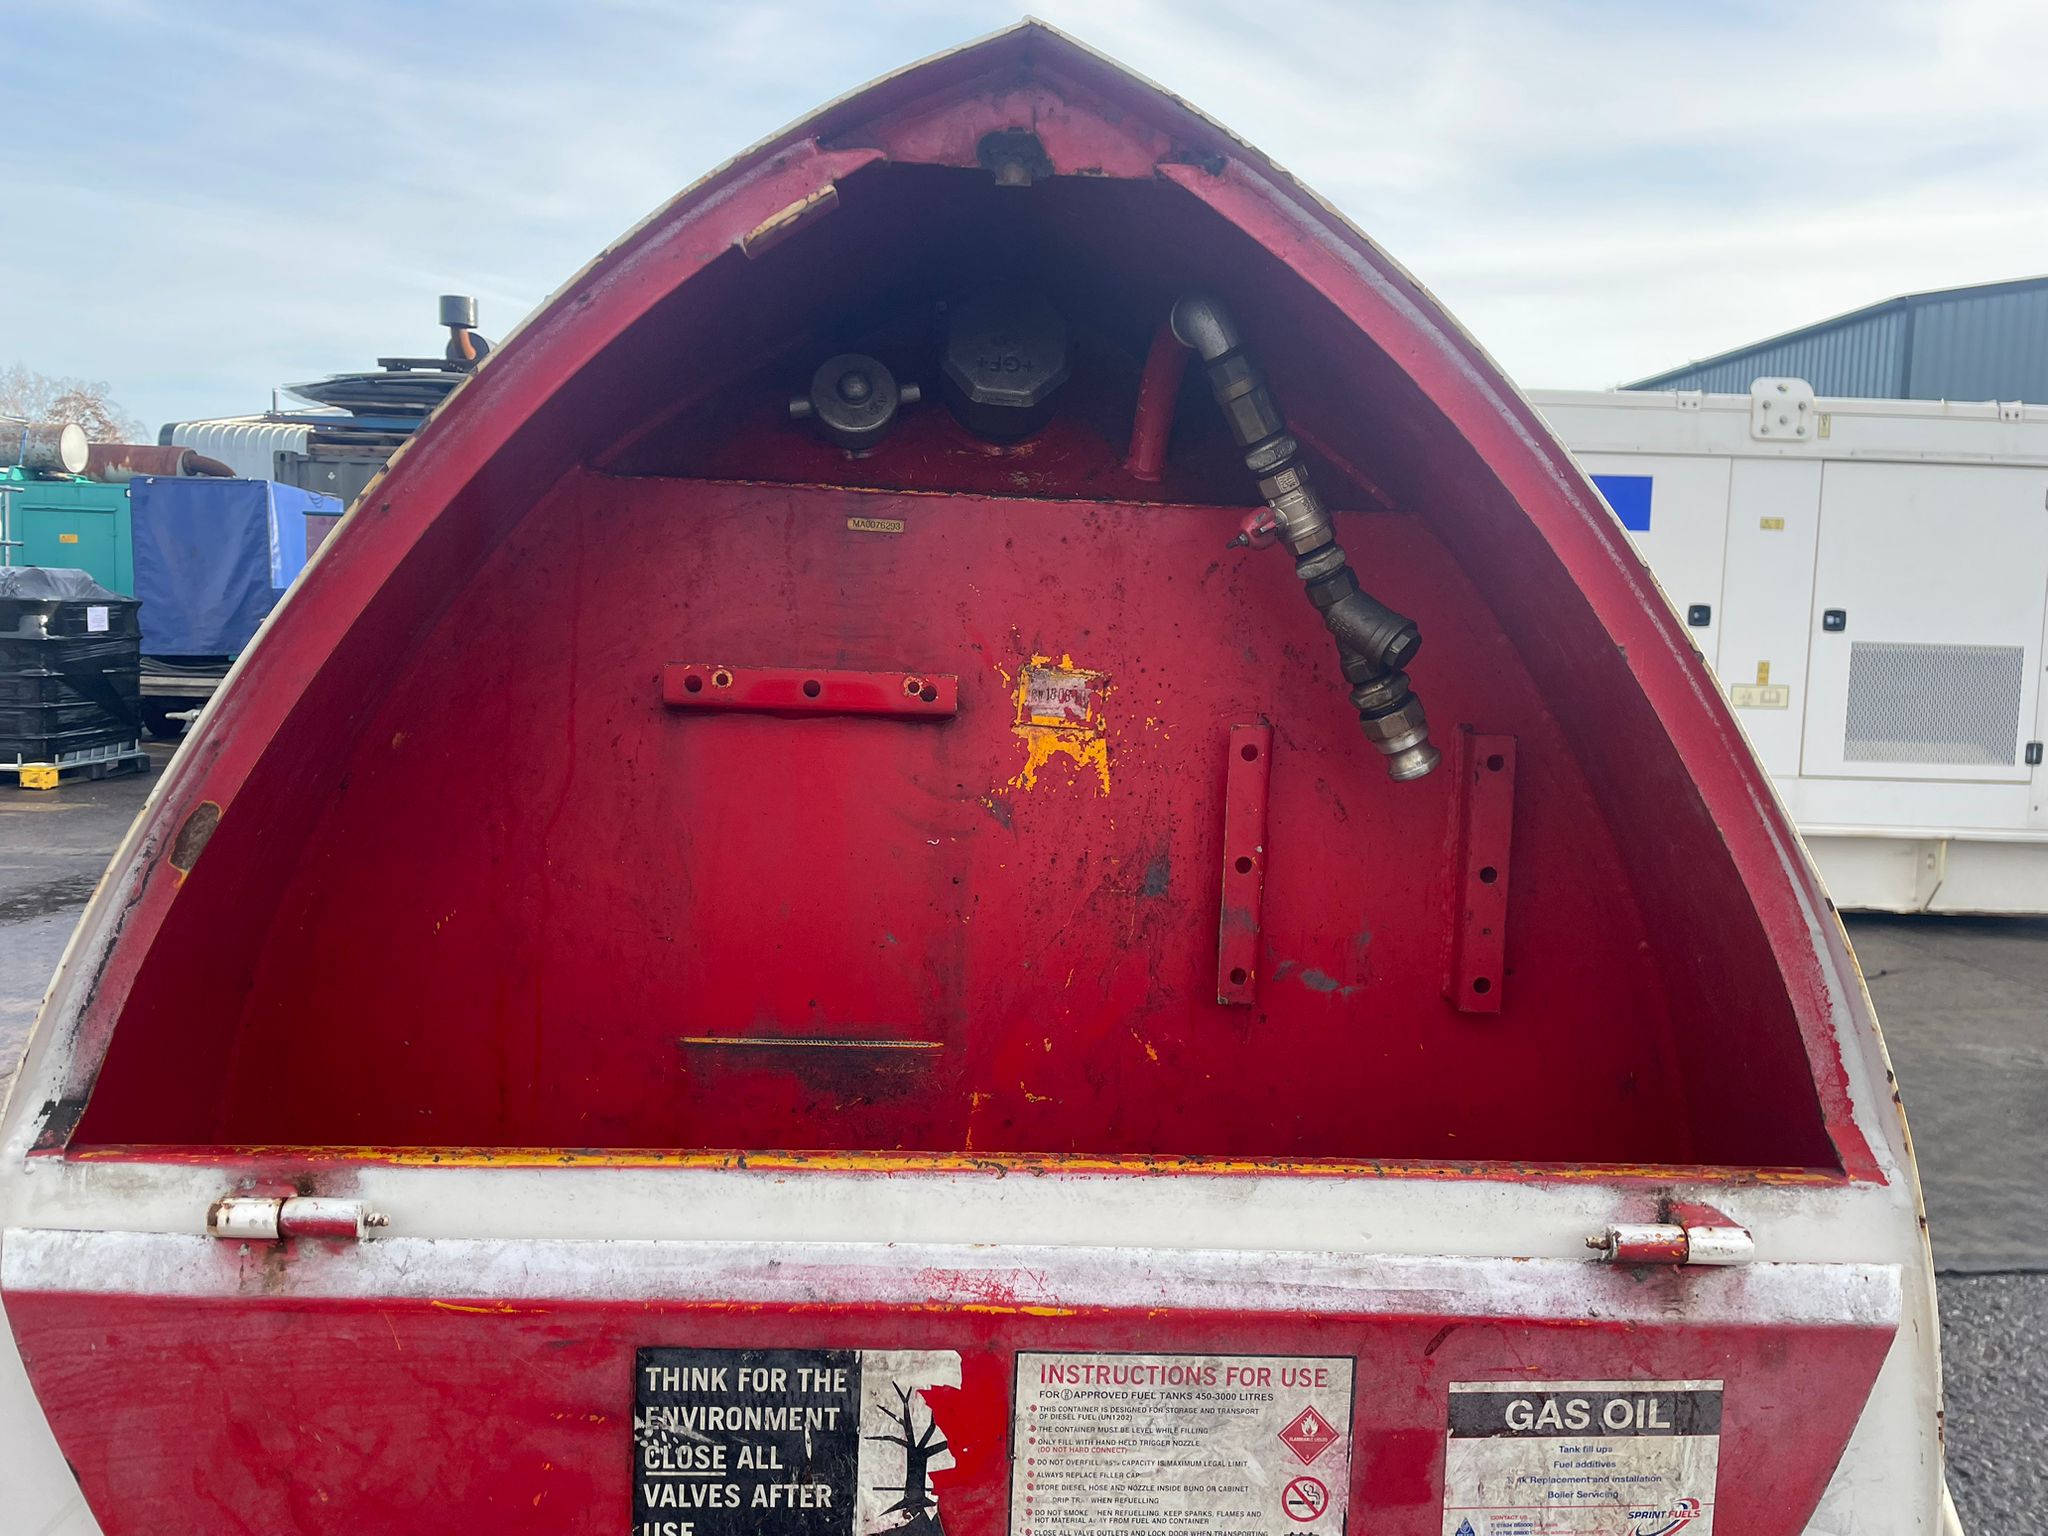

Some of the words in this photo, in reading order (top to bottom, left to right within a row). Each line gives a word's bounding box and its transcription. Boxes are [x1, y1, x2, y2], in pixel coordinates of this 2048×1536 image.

[852, 519, 901, 530] MA0076293
[646, 1367, 728, 1392] THINK
[738, 1368, 787, 1393] FOR
[797, 1368, 847, 1393] THE
[1041, 1364, 1216, 1386] INSTRUCTIONS
[1226, 1367, 1271, 1387] FOR
[1282, 1367, 1327, 1387] USE
[1040, 1390, 1059, 1399] FOR
[1074, 1390, 1128, 1399] APPROVED
[1131, 1391, 1156, 1400] FUEL
[1160, 1391, 1192, 1400] TANKS
[1195, 1392, 1237, 1401] 450-3000
[1240, 1392, 1274, 1401] LITRES
[646, 1406, 840, 1431] ENVIRONMENT
[1505, 1399, 1590, 1430] GAS
[1603, 1399, 1670, 1429] OIL
[1560, 1446, 1580, 1454] Tank
[644, 1445, 727, 1470] CLOSE
[737, 1446, 783, 1470] ALL
[1554, 1461, 1573, 1469] Fuel
[643, 1483, 740, 1508] VALVES
[751, 1484, 832, 1508] AFTER
[1577, 1491, 1618, 1499] Servicing
[1627, 1511, 1666, 1519] SPRINT
[1668, 1510, 1701, 1518] FUELS
[643, 1522, 694, 1536] USE
